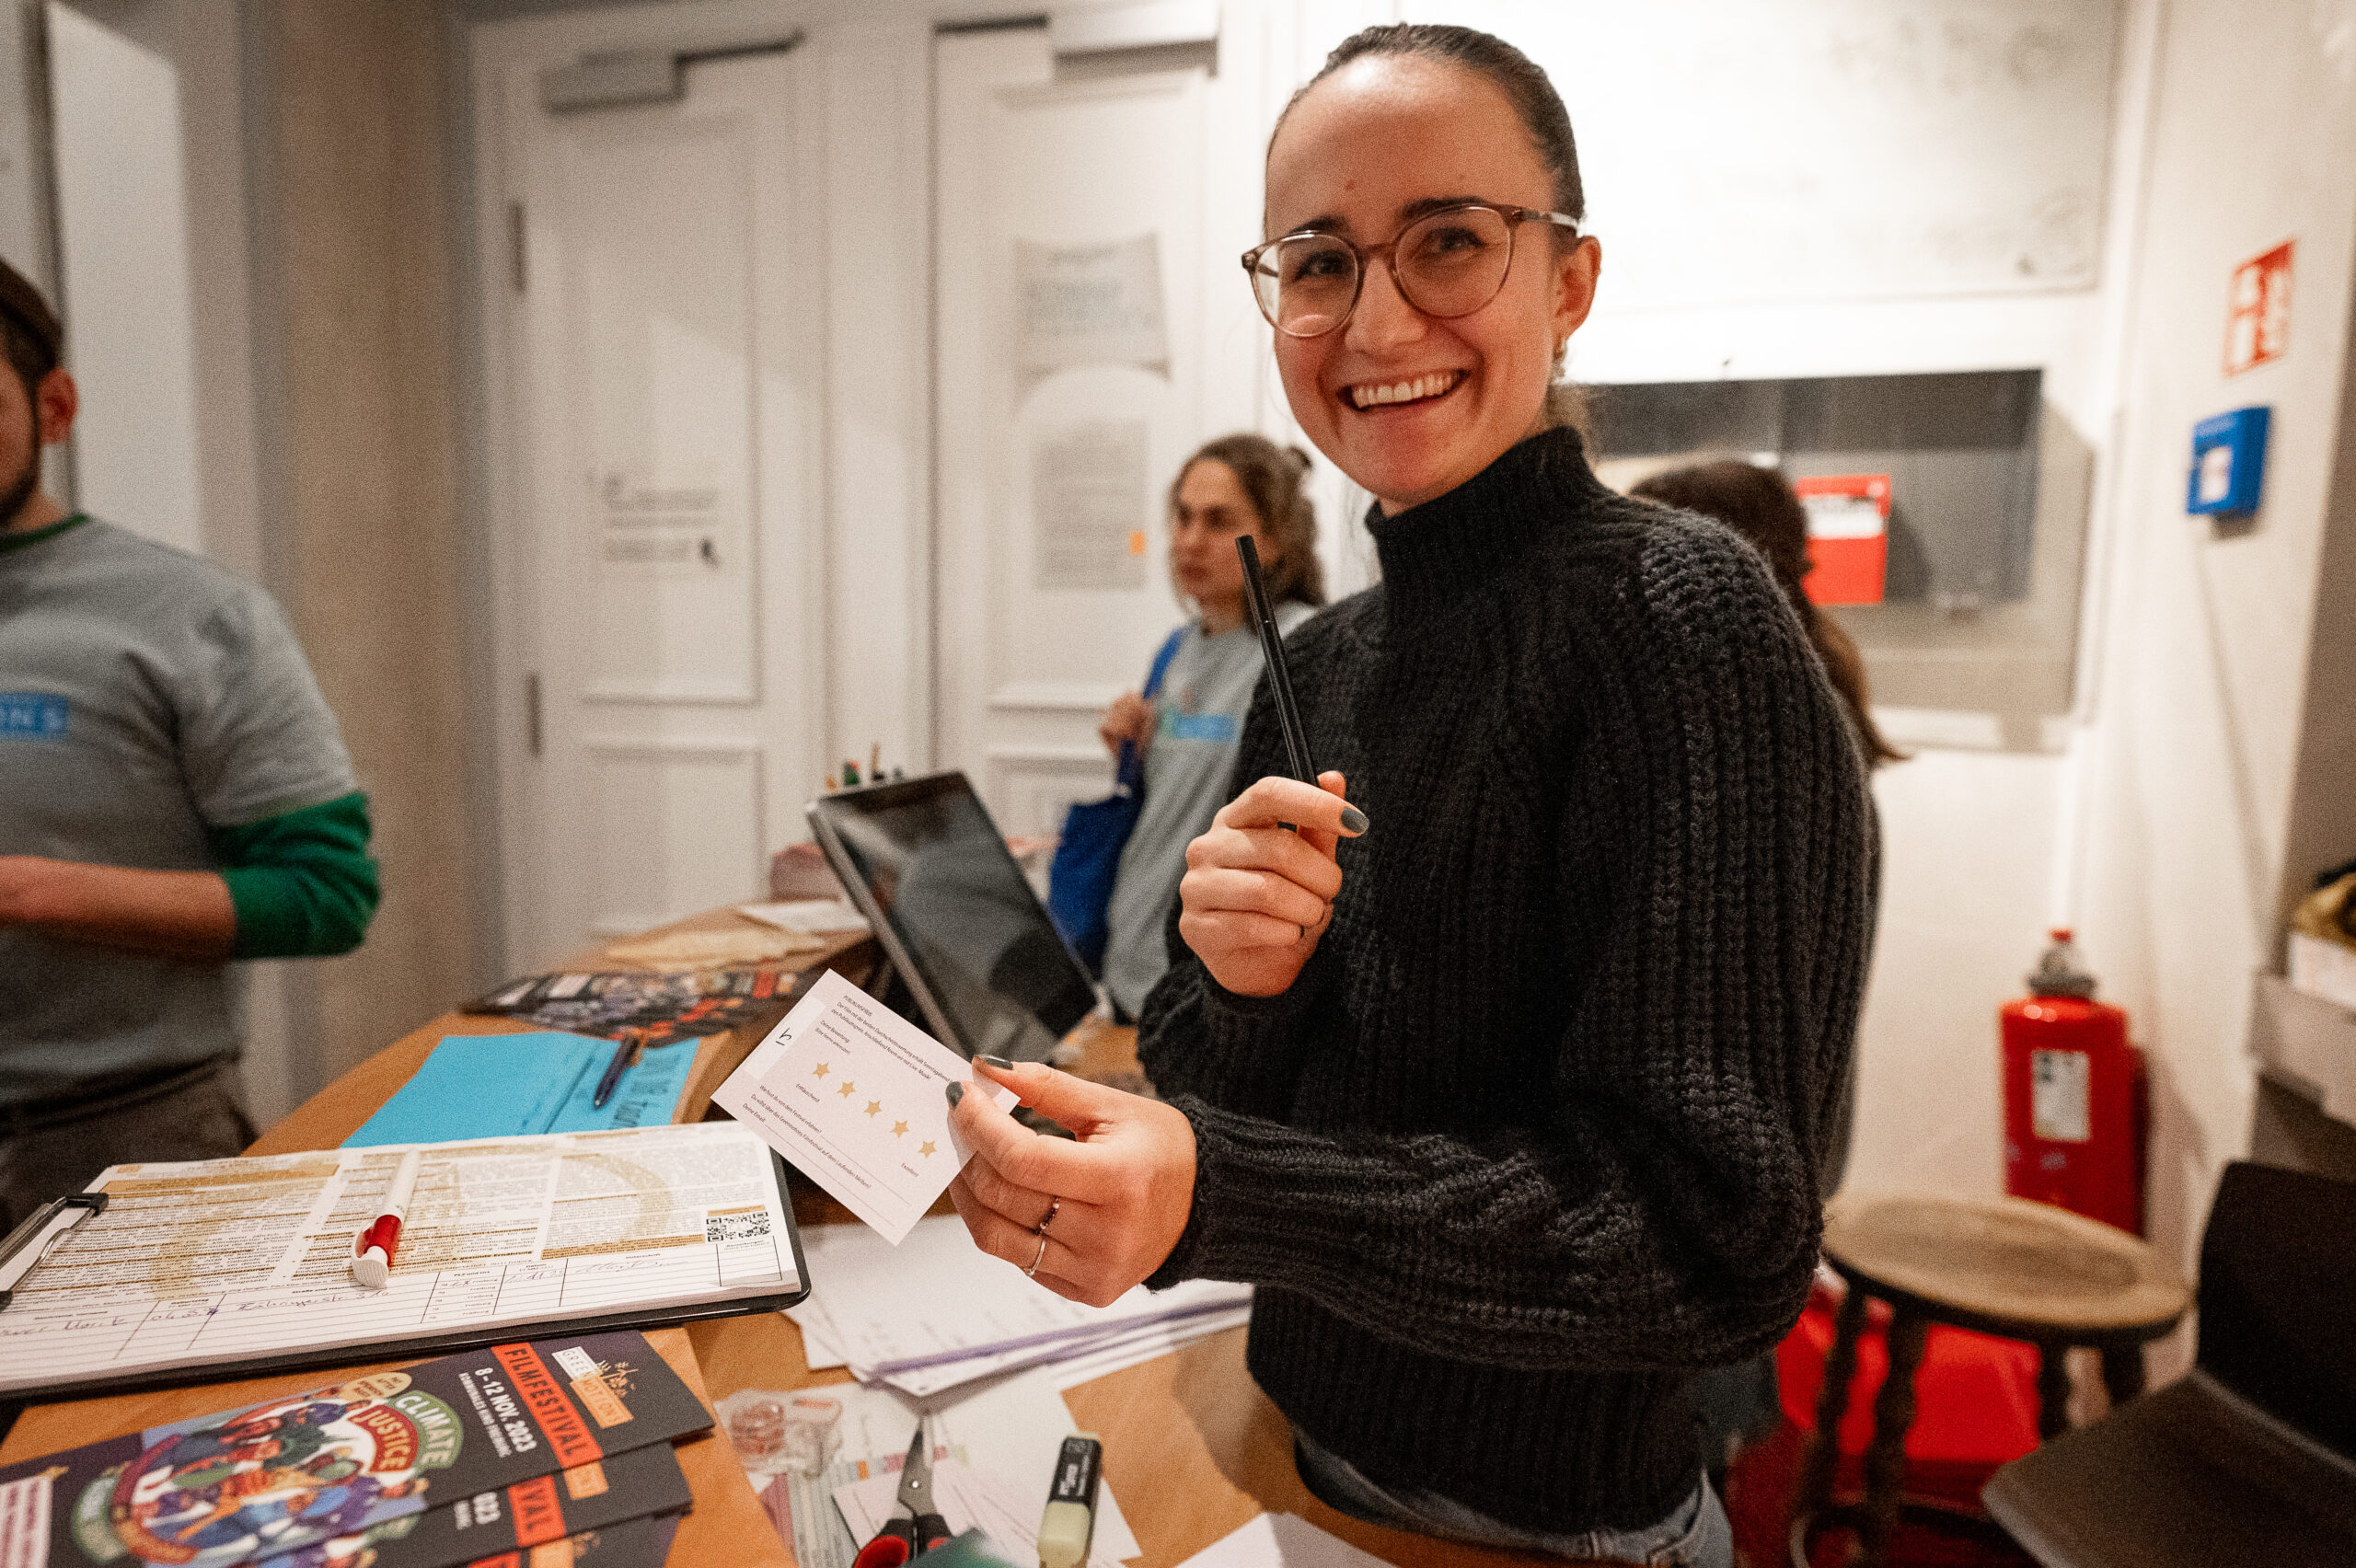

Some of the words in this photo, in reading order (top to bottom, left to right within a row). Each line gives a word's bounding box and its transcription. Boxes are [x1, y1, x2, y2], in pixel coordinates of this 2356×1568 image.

[820, 1020, 831, 1030] Deine
[862, 1020, 876, 1030] besten
[742, 1102, 755, 1113] Deine
[784, 1103, 793, 1112] dem
[791, 1110, 806, 1122] Festival
[490, 1393, 520, 1422] NOV.
[504, 1347, 588, 1457] FILMFESTIVAL
[352, 1409, 411, 1470] JUSTICE
[395, 1395, 456, 1465] CLIMATE
[504, 1420, 537, 1452] 2023
